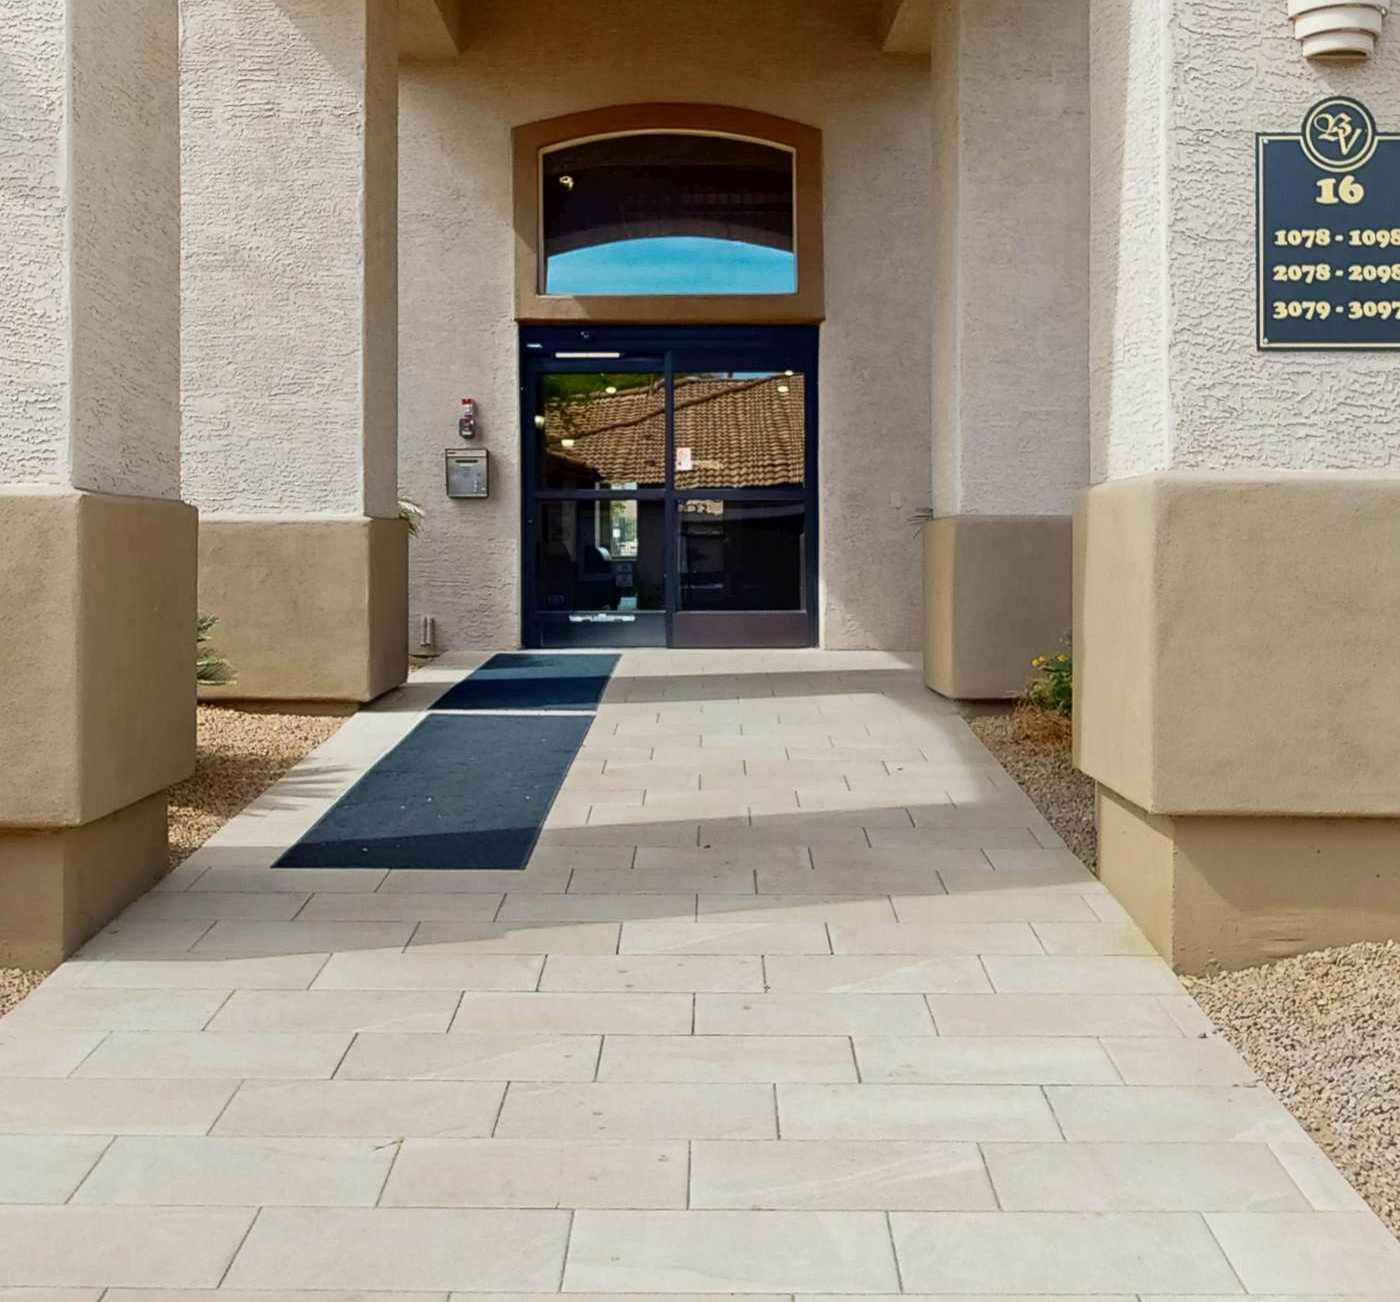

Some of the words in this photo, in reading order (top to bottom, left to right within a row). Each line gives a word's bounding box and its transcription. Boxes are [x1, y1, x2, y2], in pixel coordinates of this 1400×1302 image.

[1316, 175, 1365, 204] 16
[1274, 229, 1331, 248] 1078
[1349, 229, 1400, 248] 1098
[1273, 265, 1331, 284] 2078
[1348, 265, 1400, 284] 2098
[1273, 301, 1331, 320] 3079
[1348, 301, 1400, 320] 3097
